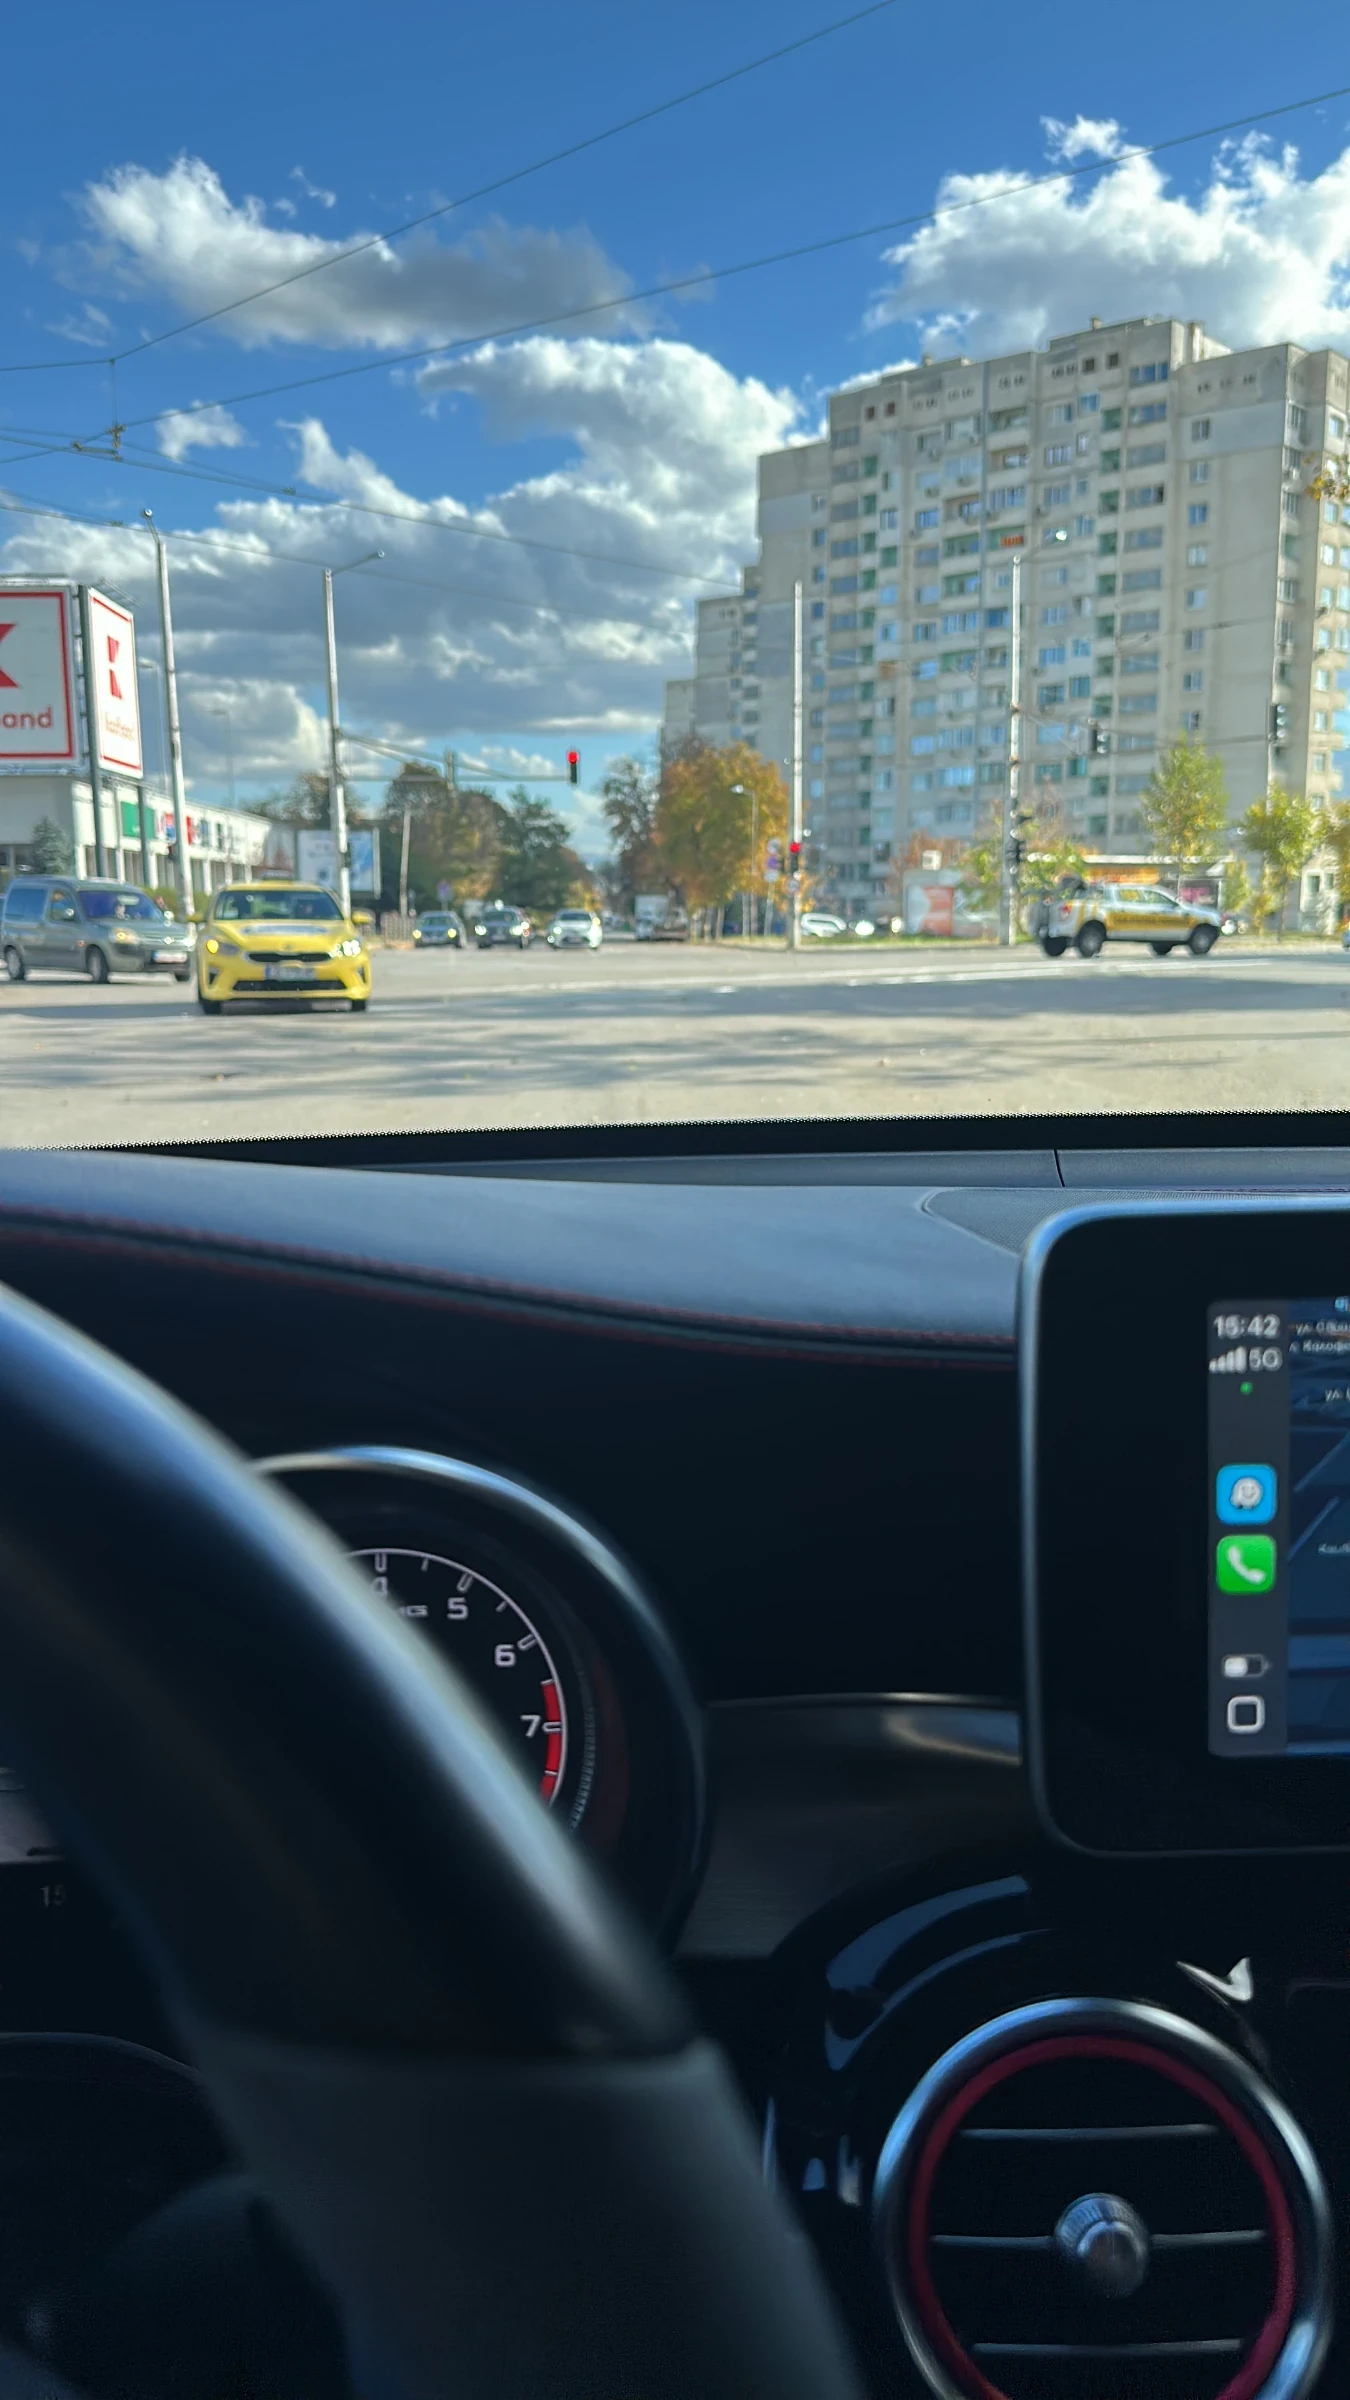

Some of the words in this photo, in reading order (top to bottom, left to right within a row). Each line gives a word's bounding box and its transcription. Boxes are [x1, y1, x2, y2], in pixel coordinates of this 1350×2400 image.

[0, 704, 52, 729] and
[446, 1597, 469, 1619] 5
[495, 1644, 516, 1667] 6
[520, 1715, 541, 1737] 7
